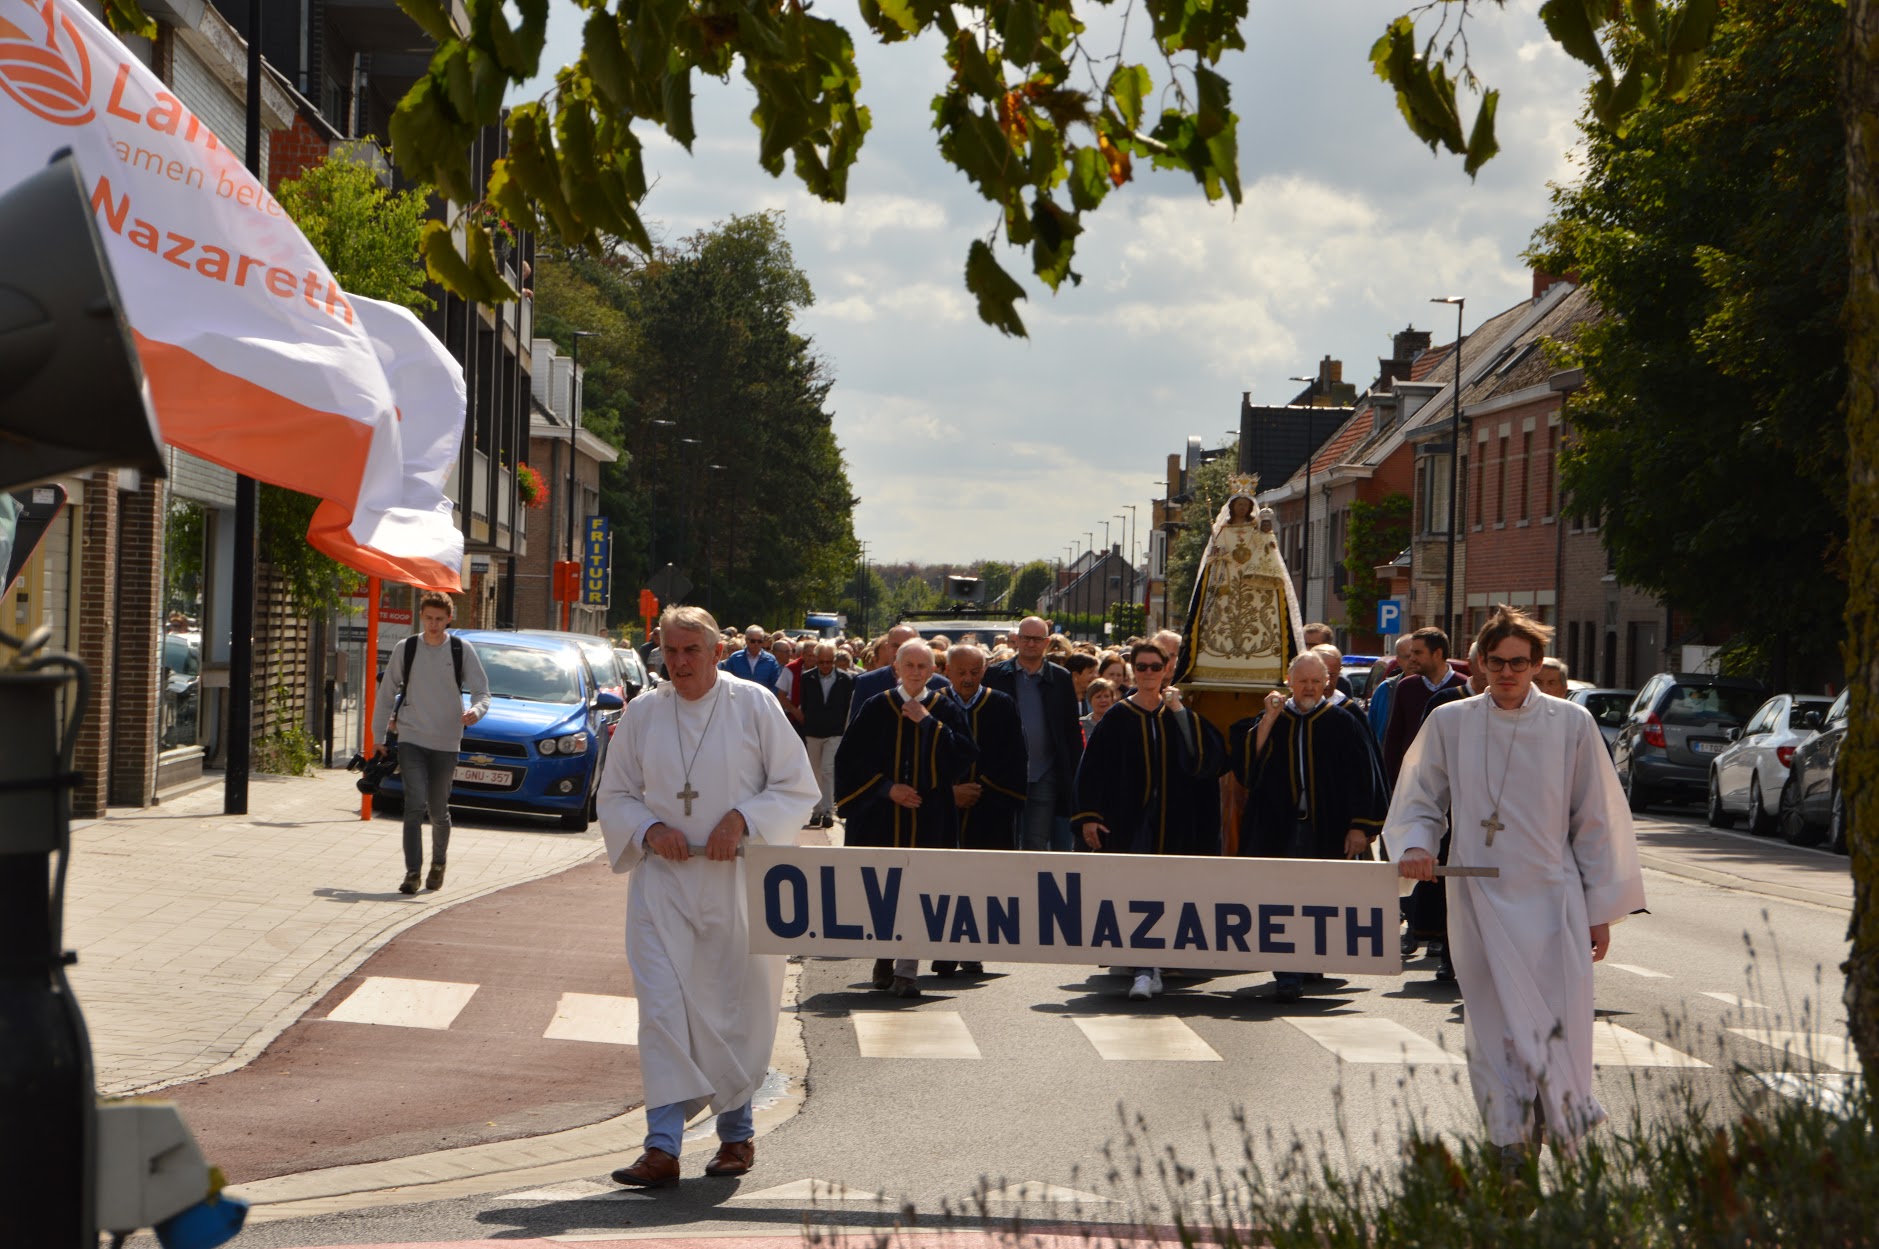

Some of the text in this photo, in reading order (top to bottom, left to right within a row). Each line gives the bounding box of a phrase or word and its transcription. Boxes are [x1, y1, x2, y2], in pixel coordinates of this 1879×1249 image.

[109, 138, 292, 223] amen bele
[91, 175, 353, 325] Nazareth
[589, 519, 604, 603] FRITUUR
[389, 612, 411, 621] KOOP
[1381, 605, 1399, 629] P
[763, 863, 1385, 959] O.L.V. VAN NAZARETH
